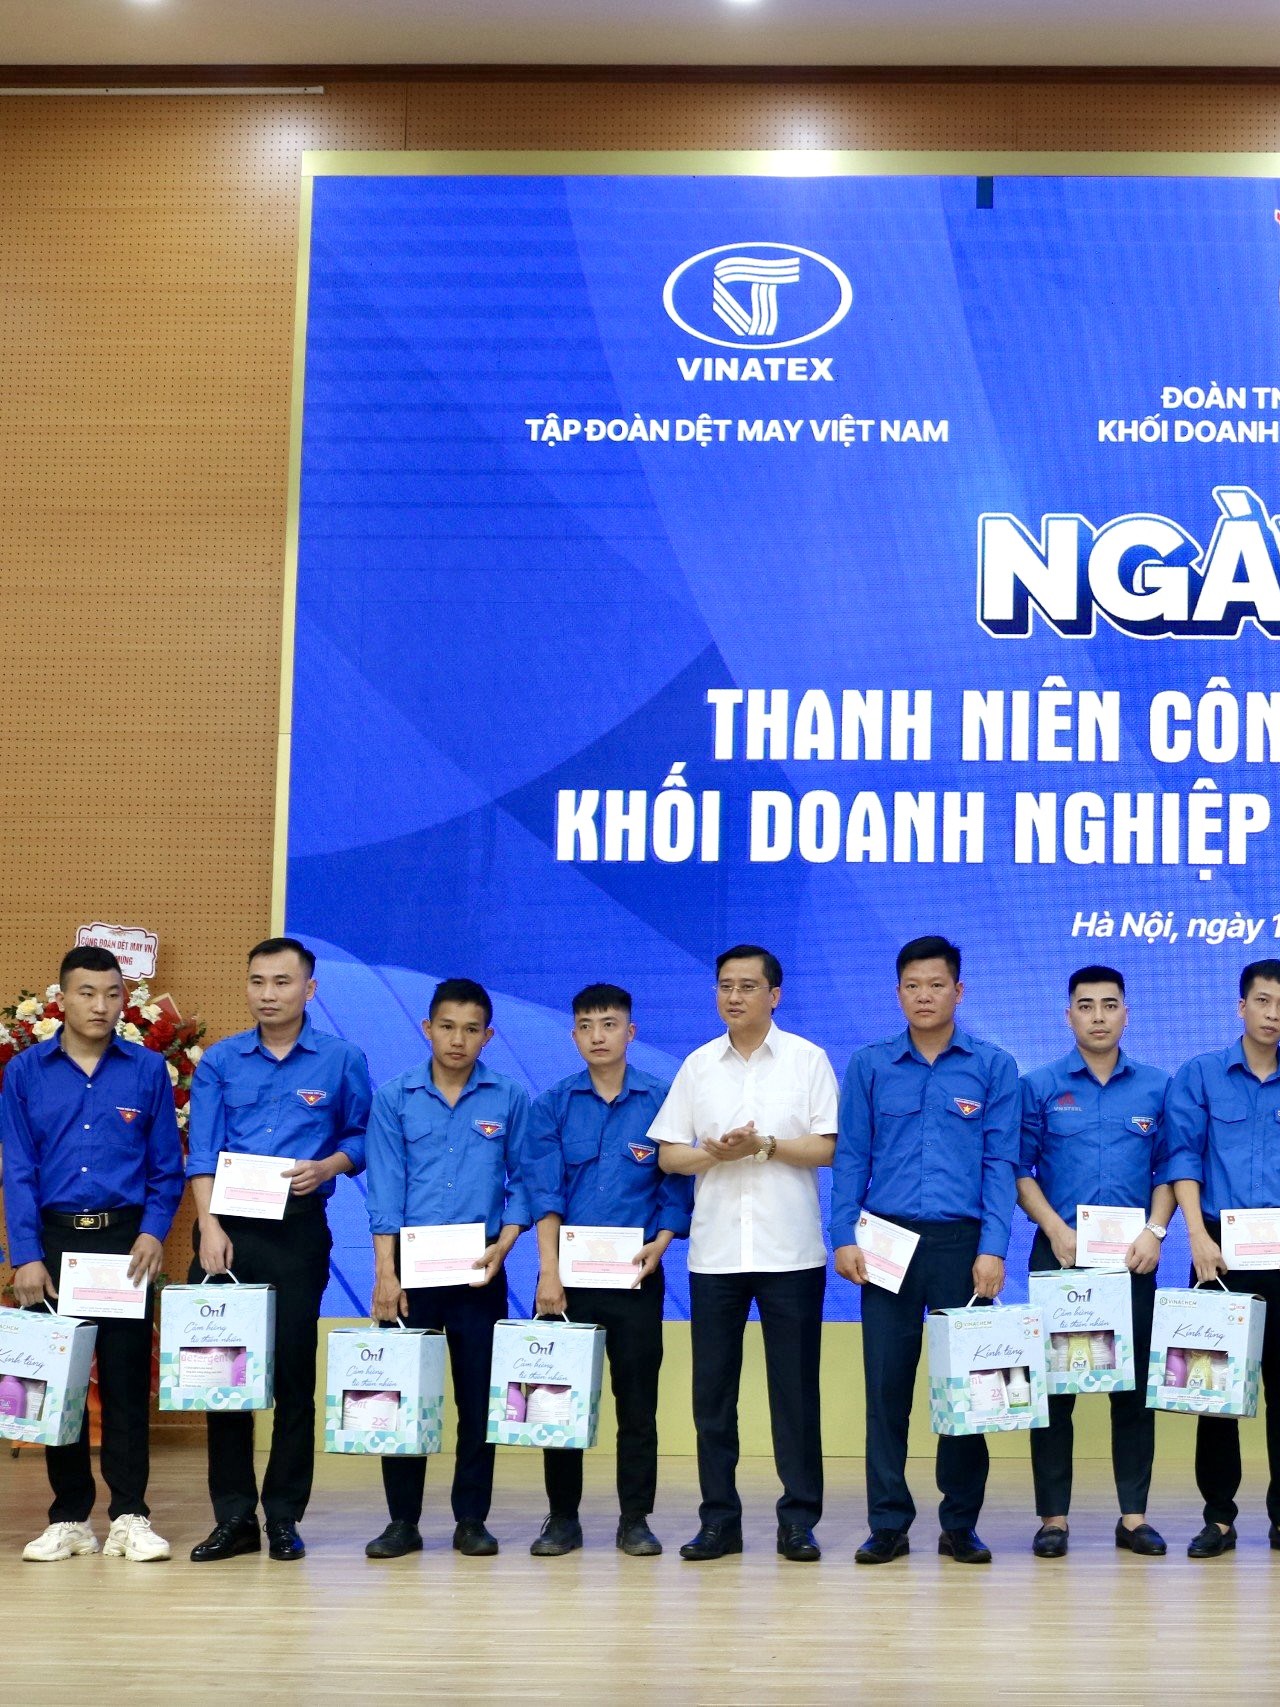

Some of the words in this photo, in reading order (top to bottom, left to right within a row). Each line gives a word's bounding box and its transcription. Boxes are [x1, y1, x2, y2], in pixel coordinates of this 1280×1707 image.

[677, 357, 834, 382] VINATEX
[1160, 381, 1247, 411] ĐOÀN
[525, 413, 583, 448] TẬP
[584, 413, 671, 443] ĐOÀN
[675, 413, 733, 448] DỆT
[737, 419, 804, 442] MAY
[809, 413, 876, 448] VIỆT
[880, 419, 949, 443] NAM
[1098, 413, 1169, 443] KHỐI
[1174, 420, 1280, 443] DOANH
[708, 688, 933, 761] THANH
[961, 675, 1121, 762] NIÊN
[556, 762, 720, 863] KHỐI
[749, 789, 985, 864] DOANH
[1014, 777, 1271, 881] NGHIỆP
[1071, 910, 1115, 938] Hà
[1119, 910, 1179, 945] Nội,
[1186, 911, 1266, 945] ngày
[130, 942, 143, 952] MAY
[144, 944, 153, 954] VN
